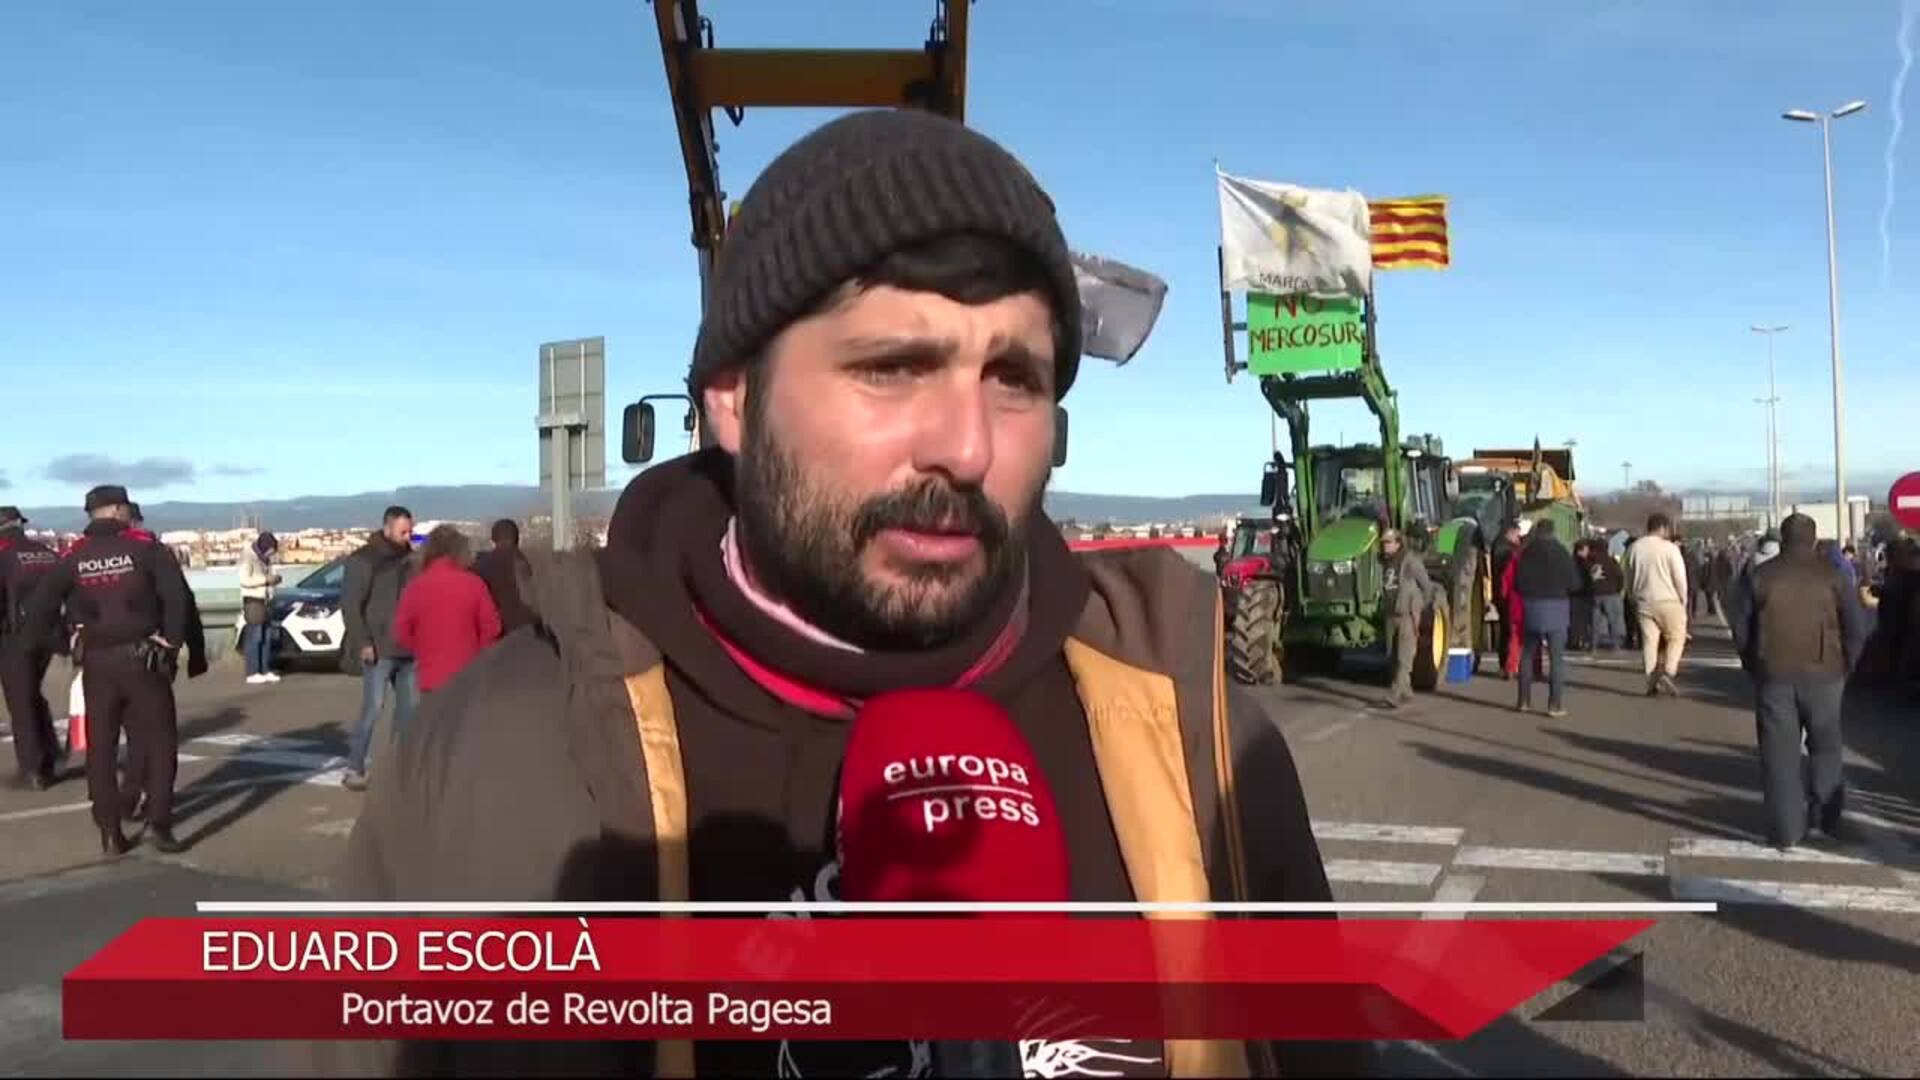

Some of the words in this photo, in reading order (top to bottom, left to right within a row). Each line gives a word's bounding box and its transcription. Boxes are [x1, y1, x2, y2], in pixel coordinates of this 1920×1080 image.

[1274, 294, 1322, 319] NO
[1250, 322, 1362, 354] MERCOSUR
[78, 555, 133, 573] POLICIA
[883, 754, 1030, 786] europa
[923, 796, 1040, 832] press
